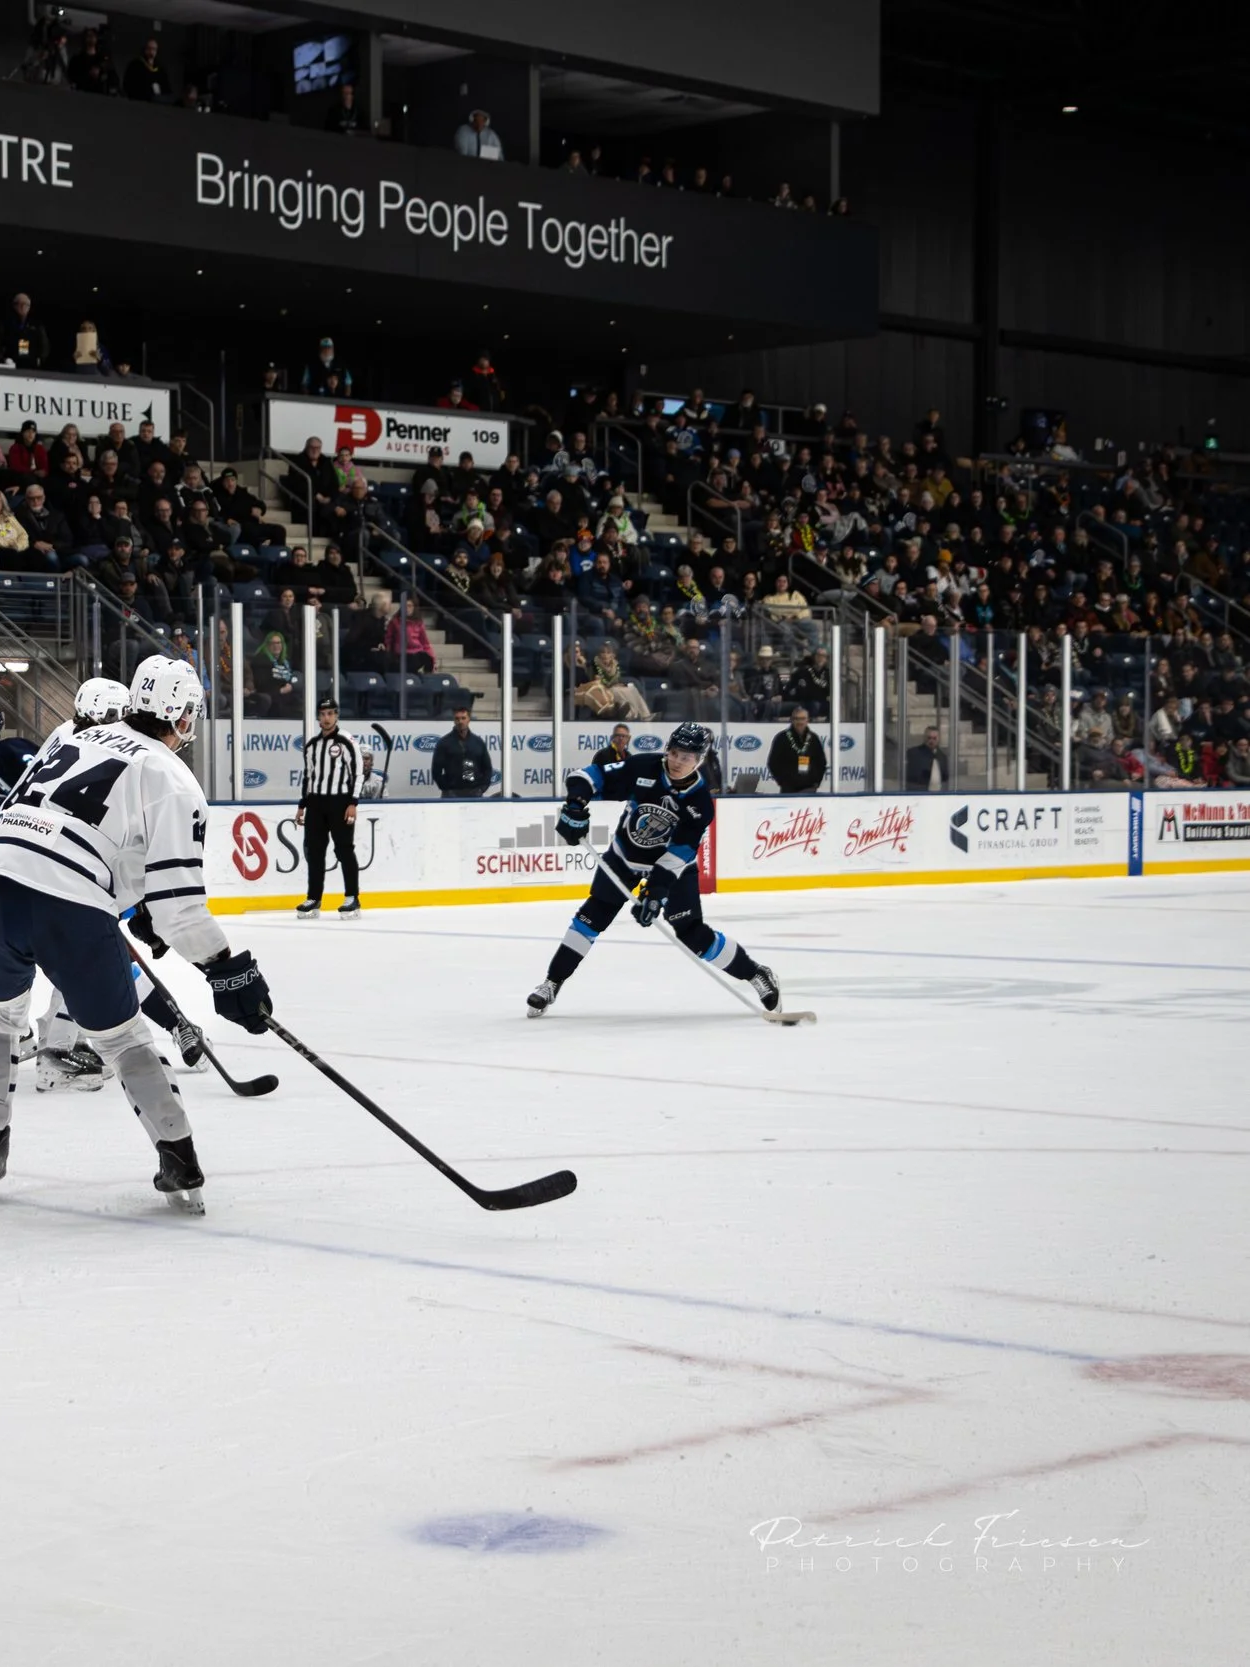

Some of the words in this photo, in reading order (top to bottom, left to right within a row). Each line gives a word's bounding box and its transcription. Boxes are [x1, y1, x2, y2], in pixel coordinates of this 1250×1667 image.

[196, 152, 366, 238] Bringing
[378, 181, 509, 252] People
[518, 202, 673, 270] Together
[3, 392, 133, 422] FURNITURE
[386, 417, 451, 443] Penner
[472, 429, 500, 444] 109
[386, 442, 450, 456] AUCTIS
[141, 677, 155, 692] 24
[976, 806, 1063, 831] CRAFT
[1182, 803, 1225, 821] McMunn
[1, 817, 53, 836] PHARMACY
[752, 807, 828, 860] Smitty's
[843, 805, 914, 857] Smitty's
[977, 838, 1027, 850] FINANCIAL
[1028, 838, 1059, 848] GROUP
[476, 852, 563, 876] SCHINKEL
[668, 909, 692, 921] CCM
[209, 963, 261, 992] CCM
